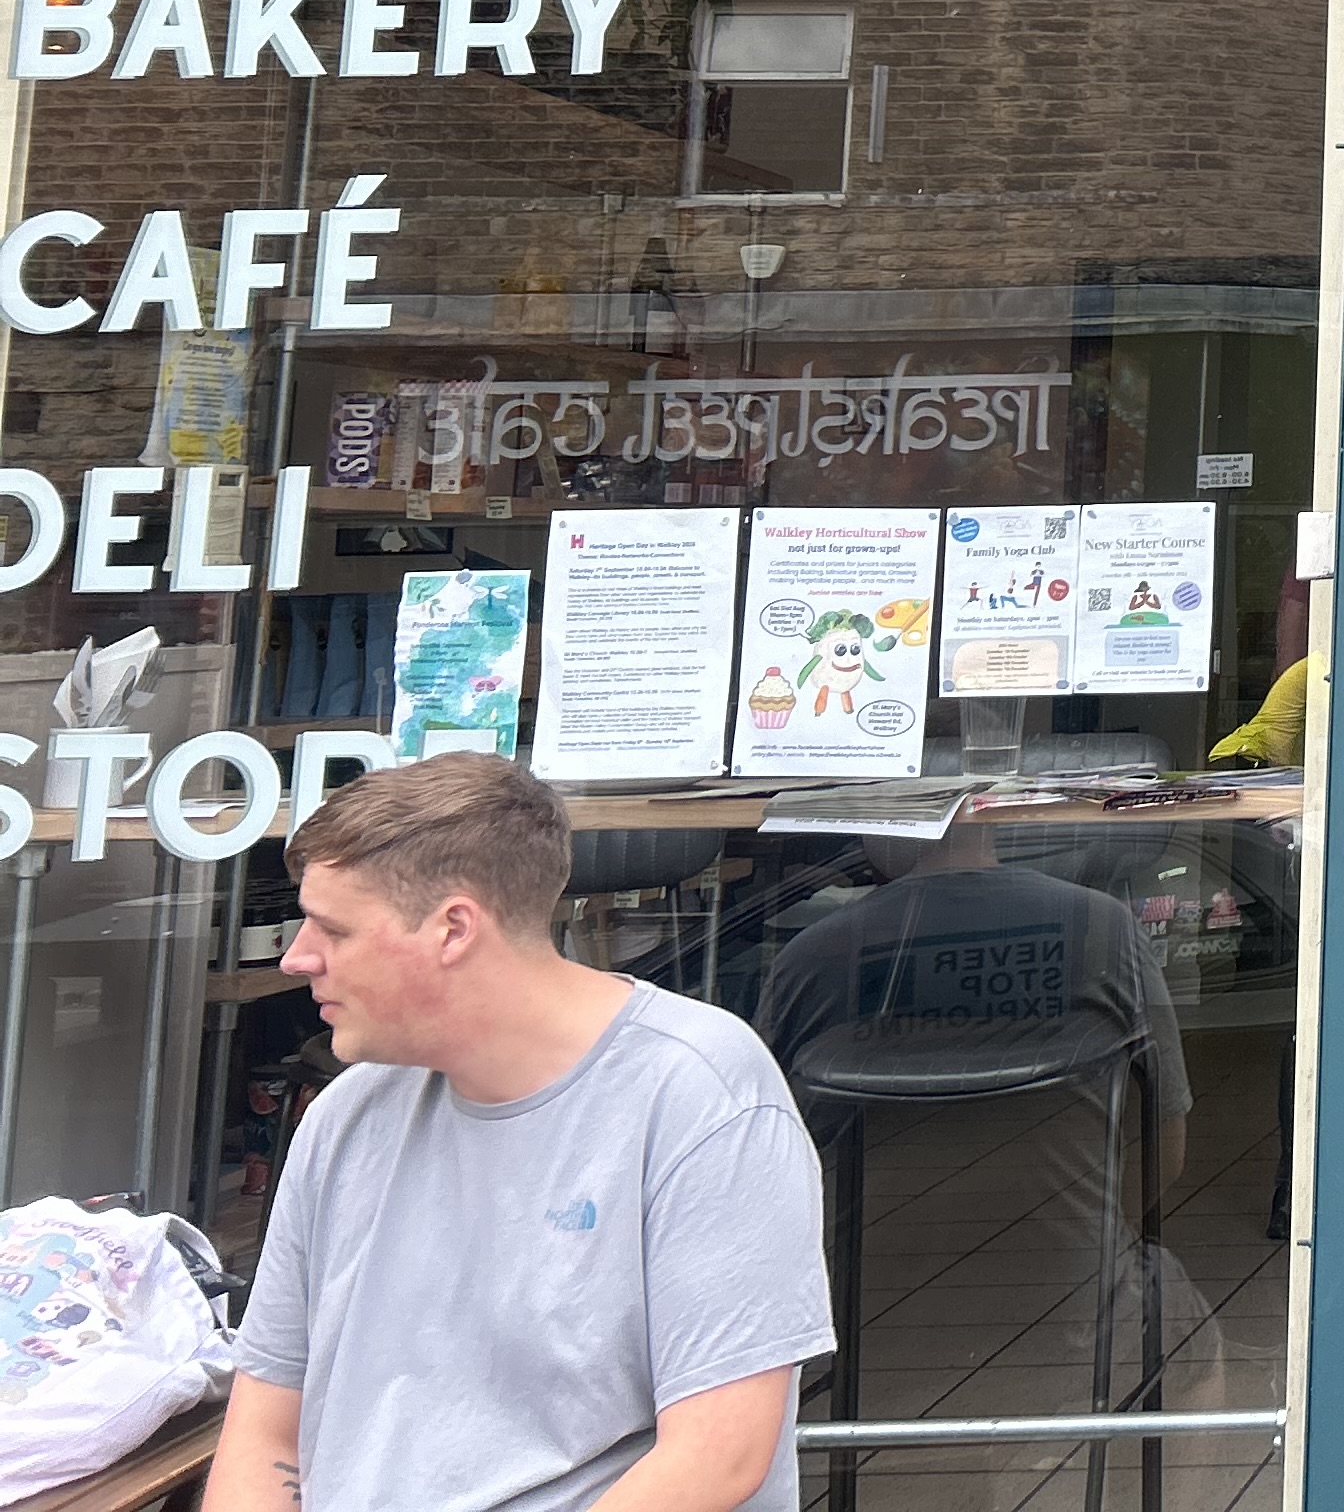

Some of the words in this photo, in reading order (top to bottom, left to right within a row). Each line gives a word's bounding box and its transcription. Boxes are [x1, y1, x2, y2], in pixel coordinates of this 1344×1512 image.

[0, 173, 401, 334] CAFÉ
[764, 527, 812, 540] Walkley
[815, 527, 891, 538] Horticultural
[894, 527, 927, 538] Show
[788, 544, 804, 553] not
[807, 543, 826, 554] just
[828, 543, 844, 553] for
[845, 543, 901, 554] grown-ups!
[1085, 539, 1113, 550] New
[1116, 538, 1160, 549] Starter
[1161, 537, 1206, 548] Course
[966, 547, 1001, 558] Family
[1003, 547, 1028, 557] Yoga
[1031, 545, 1056, 555] Club
